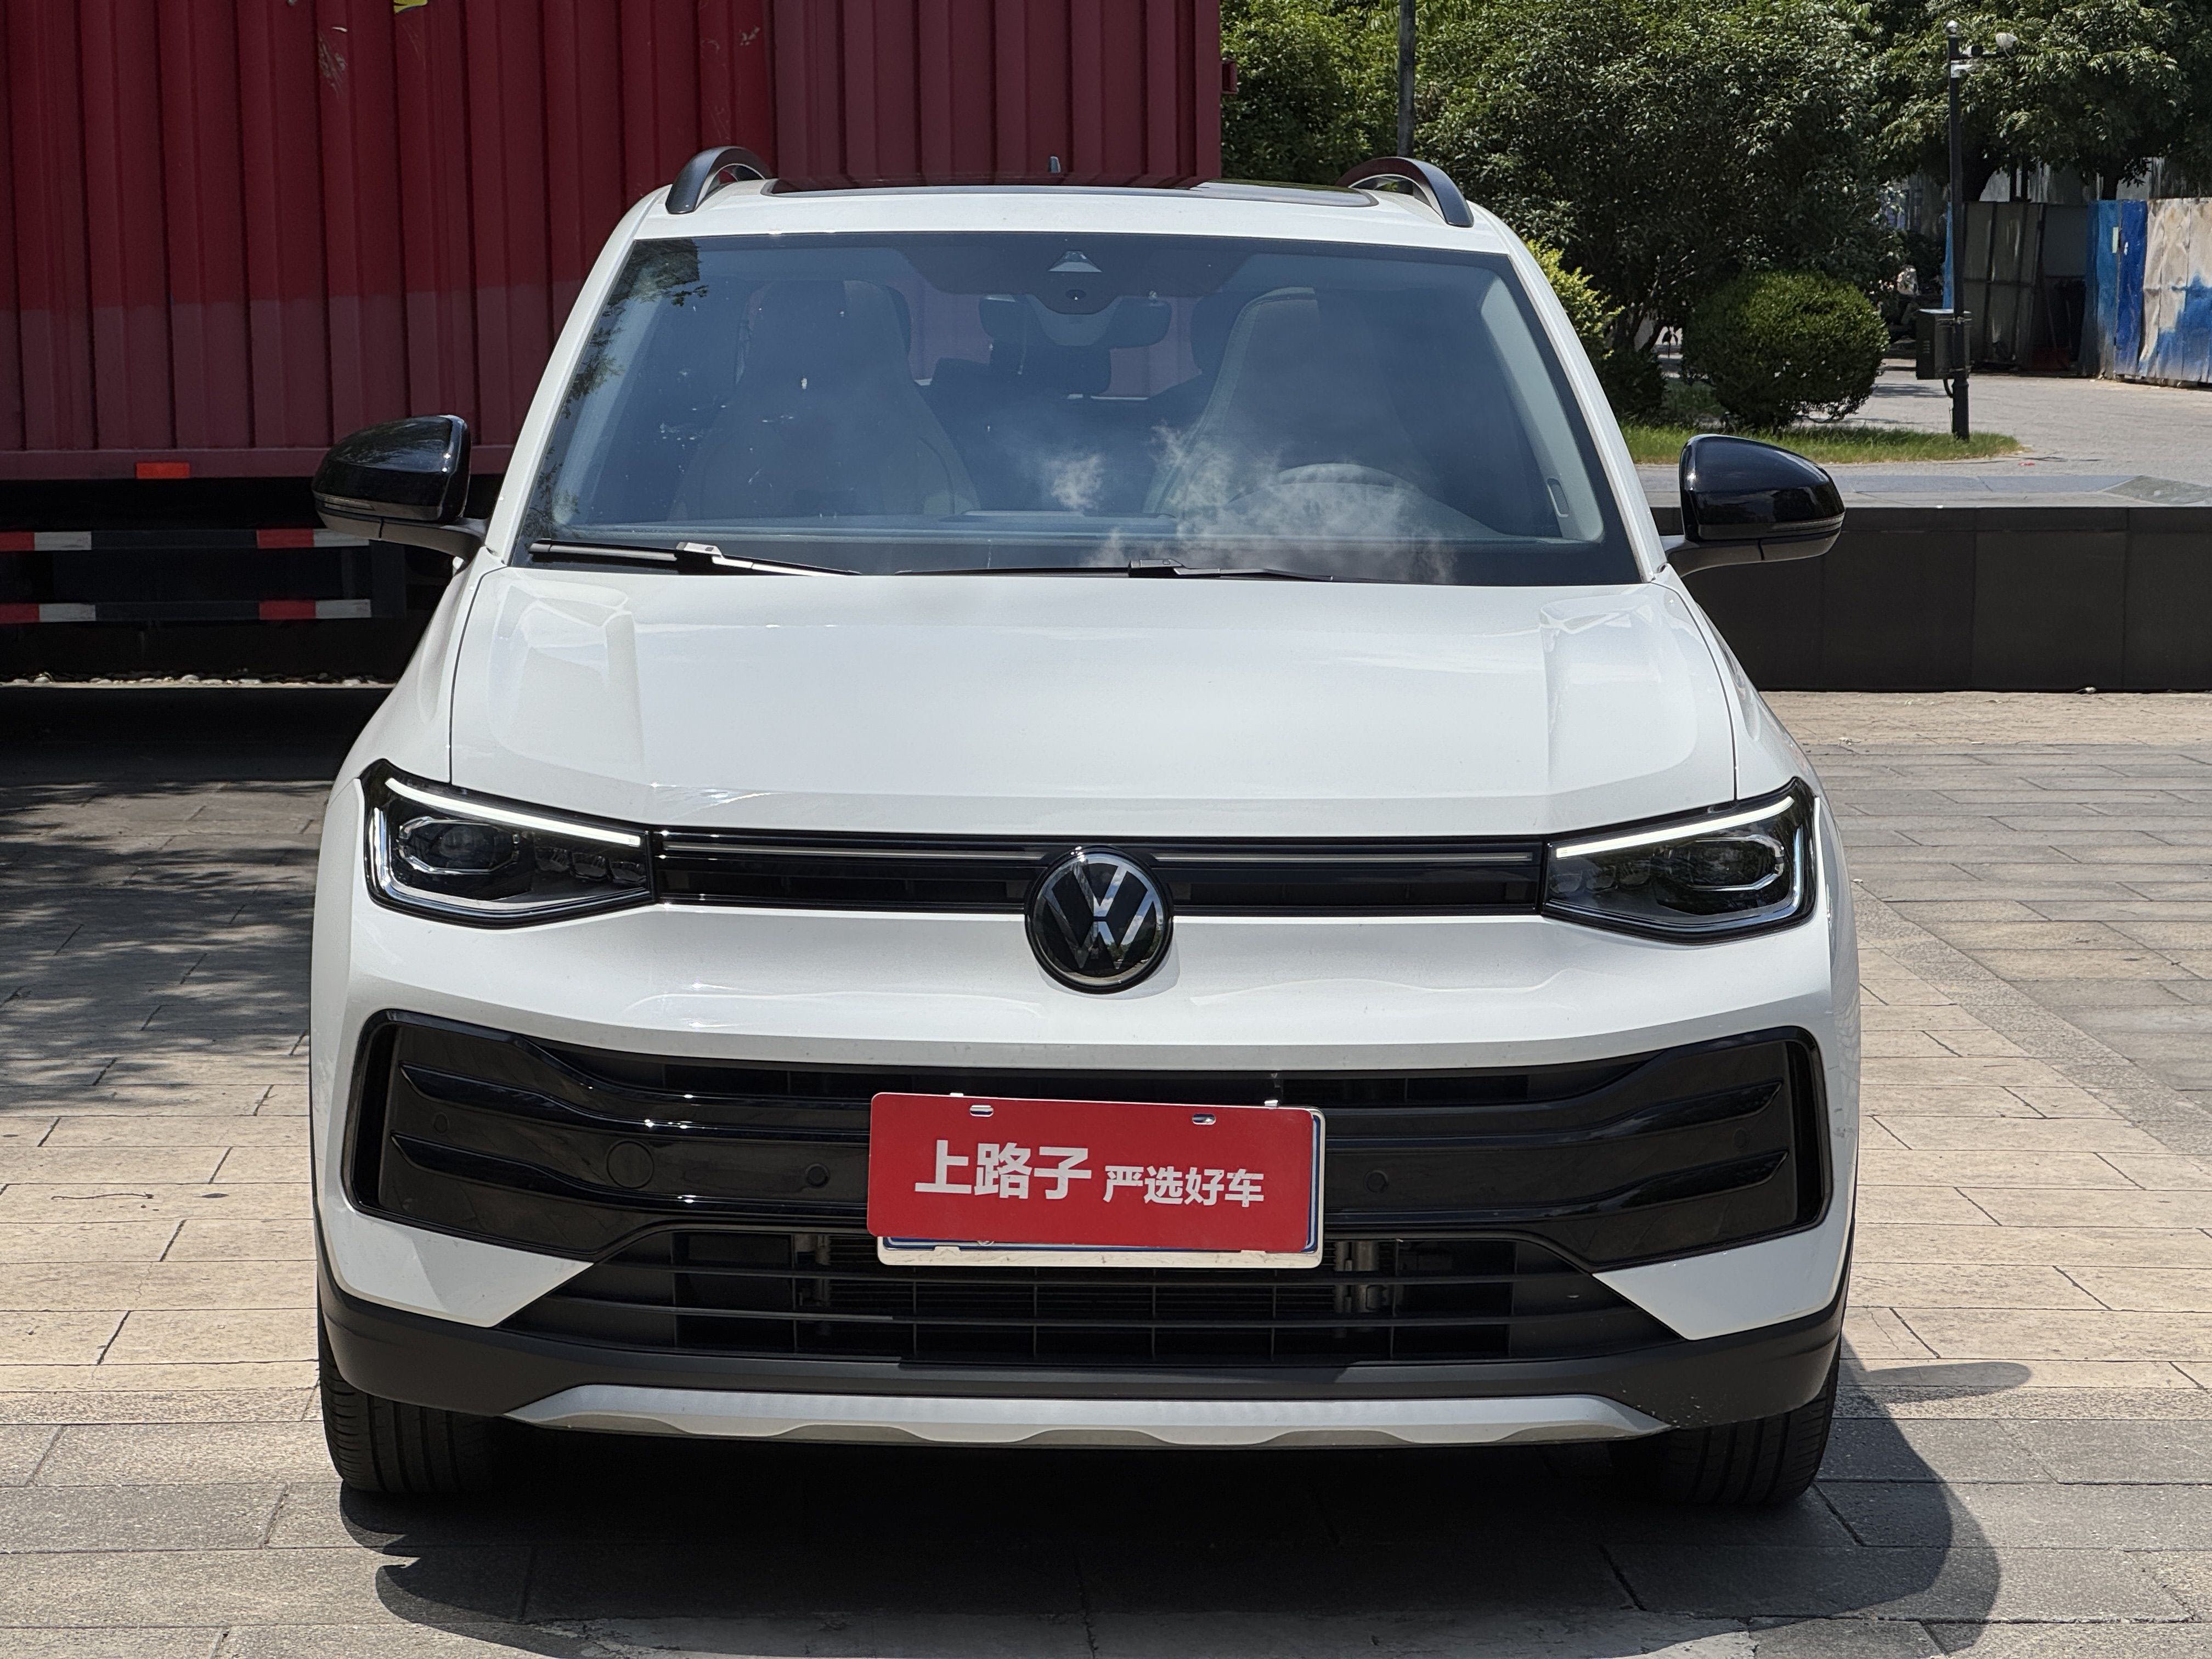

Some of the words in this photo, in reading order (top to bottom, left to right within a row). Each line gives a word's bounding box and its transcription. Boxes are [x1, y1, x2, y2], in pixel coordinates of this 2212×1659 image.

[915, 1139, 1092, 1200] 上路子
[1103, 1165, 1265, 1207] 严选好车
